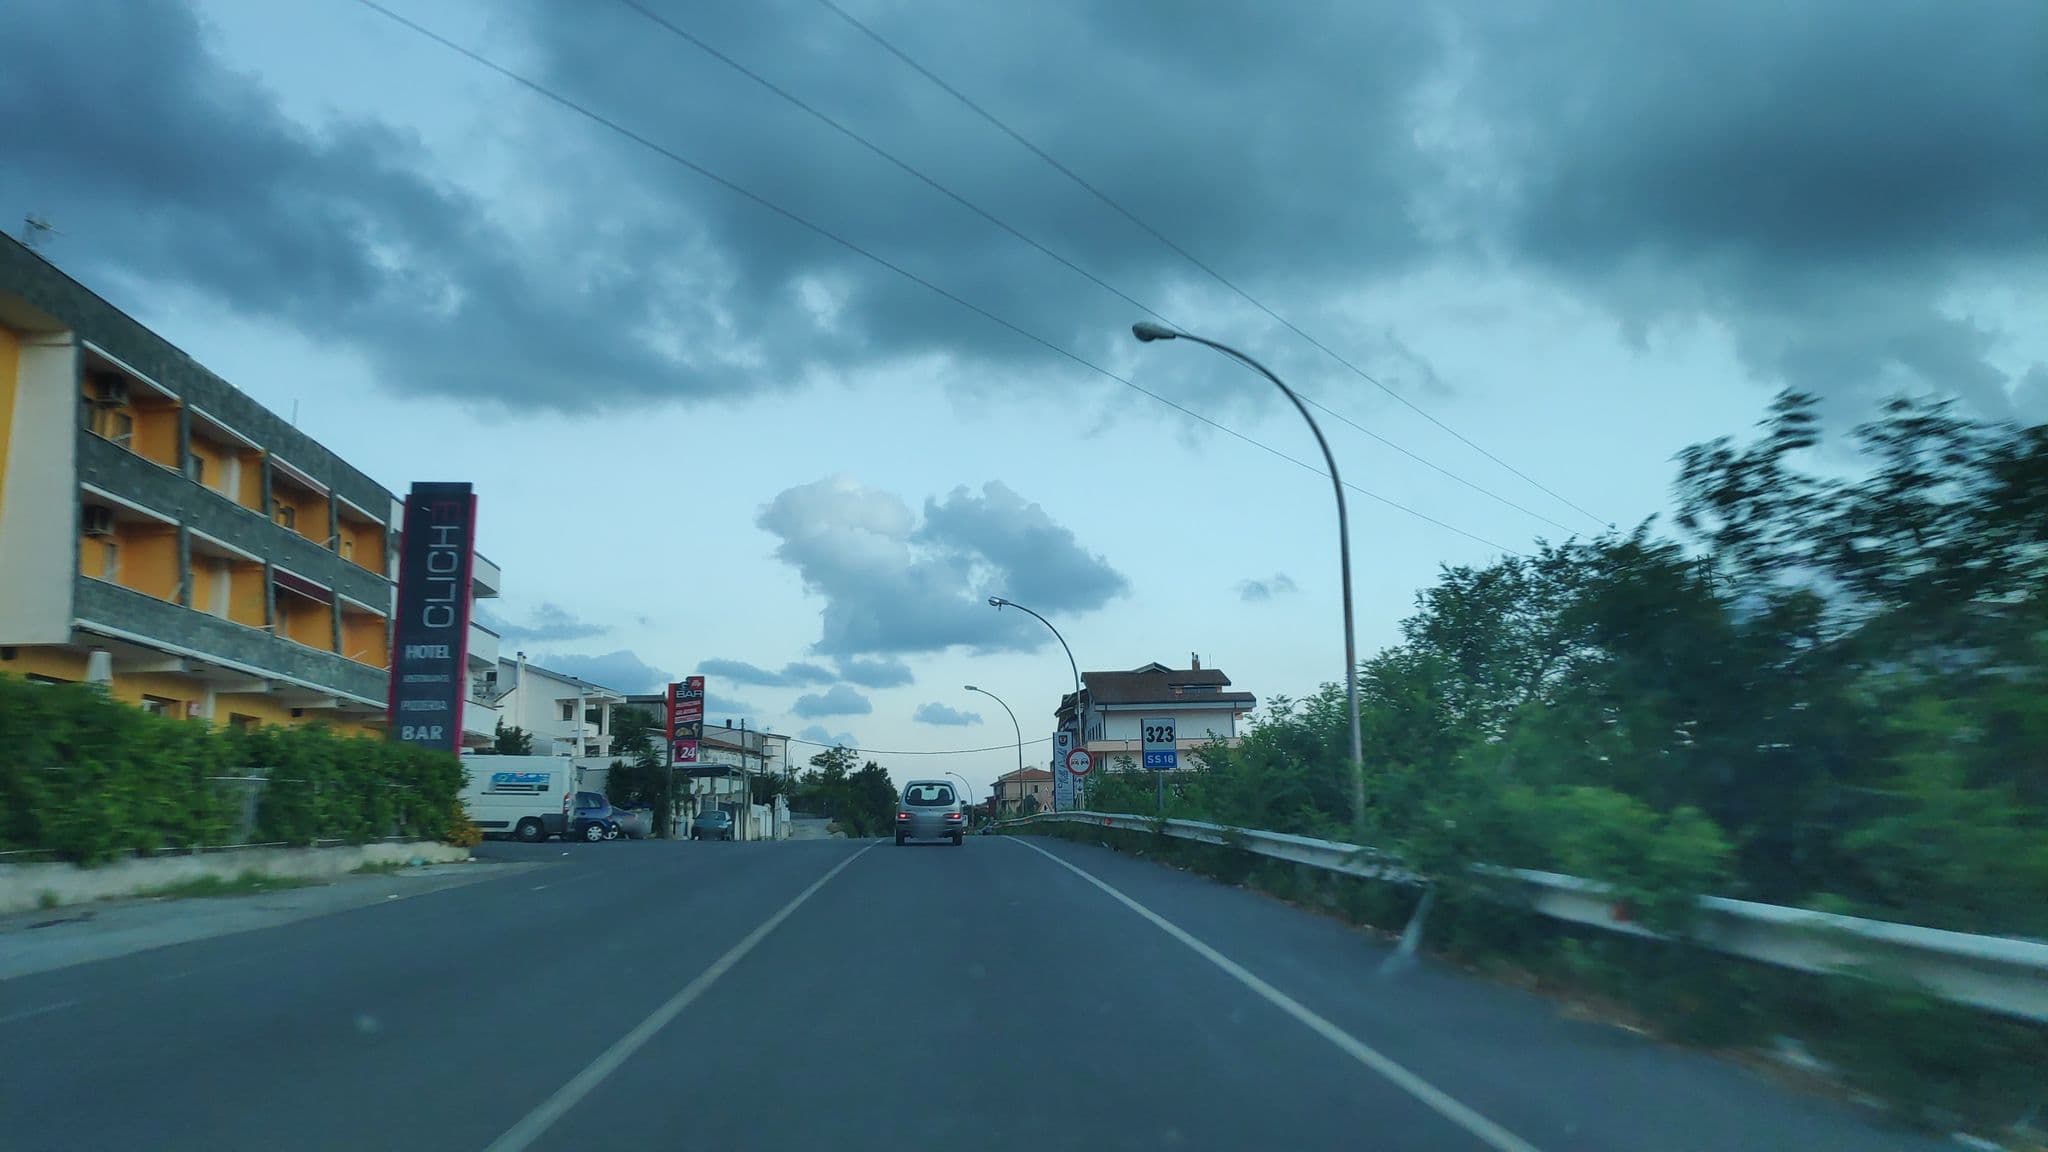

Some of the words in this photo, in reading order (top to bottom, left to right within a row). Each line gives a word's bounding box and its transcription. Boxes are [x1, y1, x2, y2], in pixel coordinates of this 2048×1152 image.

[405, 644, 450, 659] HOTEL
[676, 690, 703, 698] BAR
[401, 725, 443, 741] BAR
[1146, 726, 1175, 743] 323
[681, 747, 695, 758] 24
[1147, 754, 1162, 764] SS
[1165, 754, 1175, 764] 18
